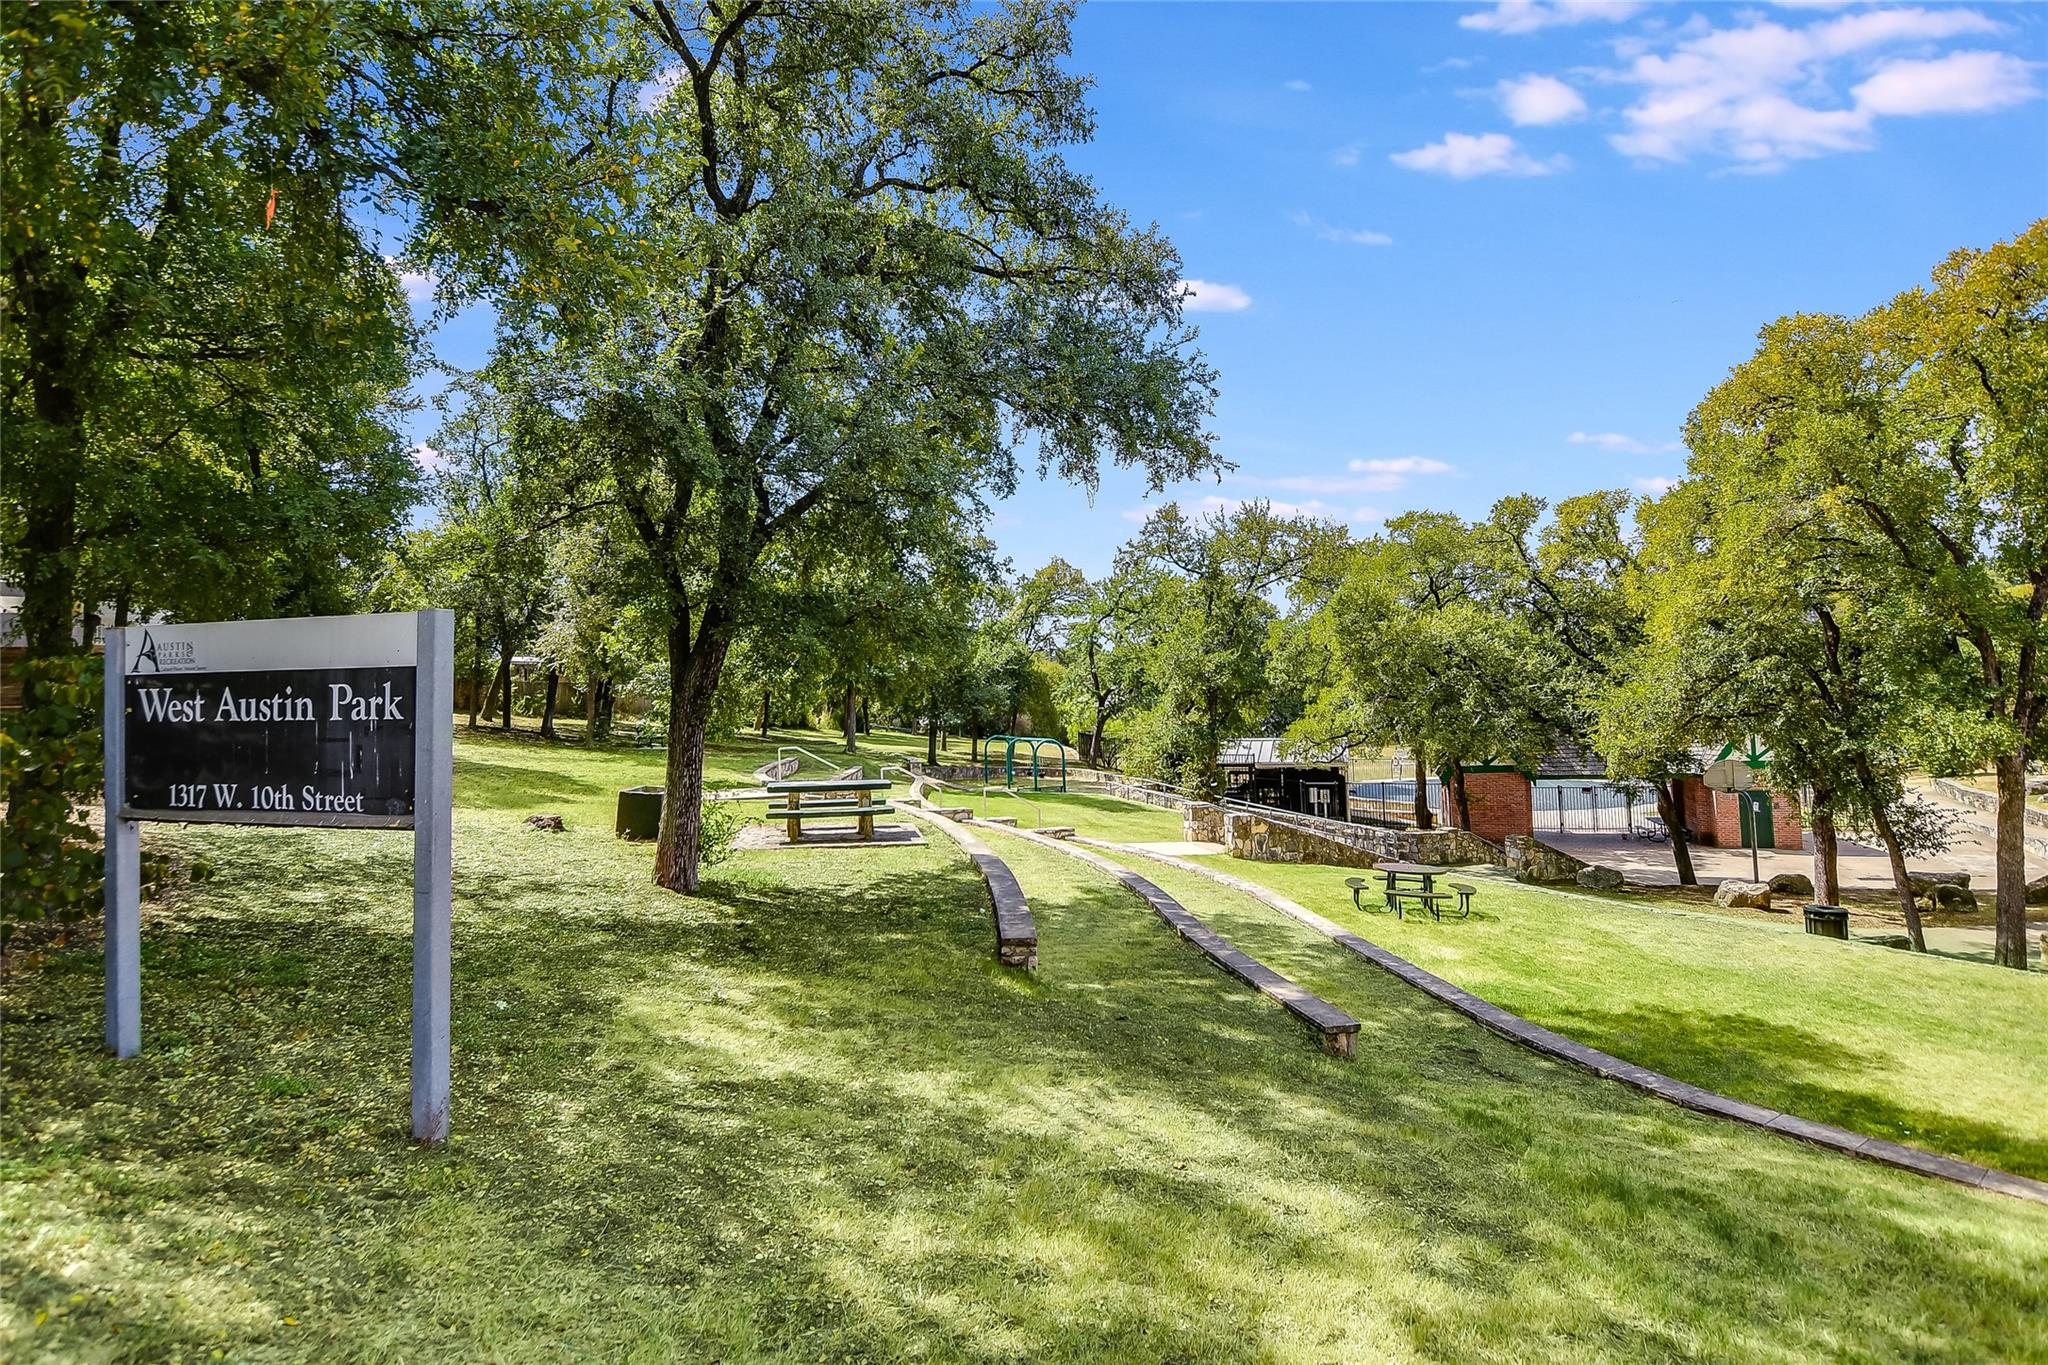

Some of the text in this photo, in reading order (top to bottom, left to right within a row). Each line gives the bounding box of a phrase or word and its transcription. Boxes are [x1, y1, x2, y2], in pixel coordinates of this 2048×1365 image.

[157, 641, 193, 651] AUSTIN
[138, 681, 405, 723] West Austin Park
[168, 783, 365, 813] 1317 W. 10th Street
